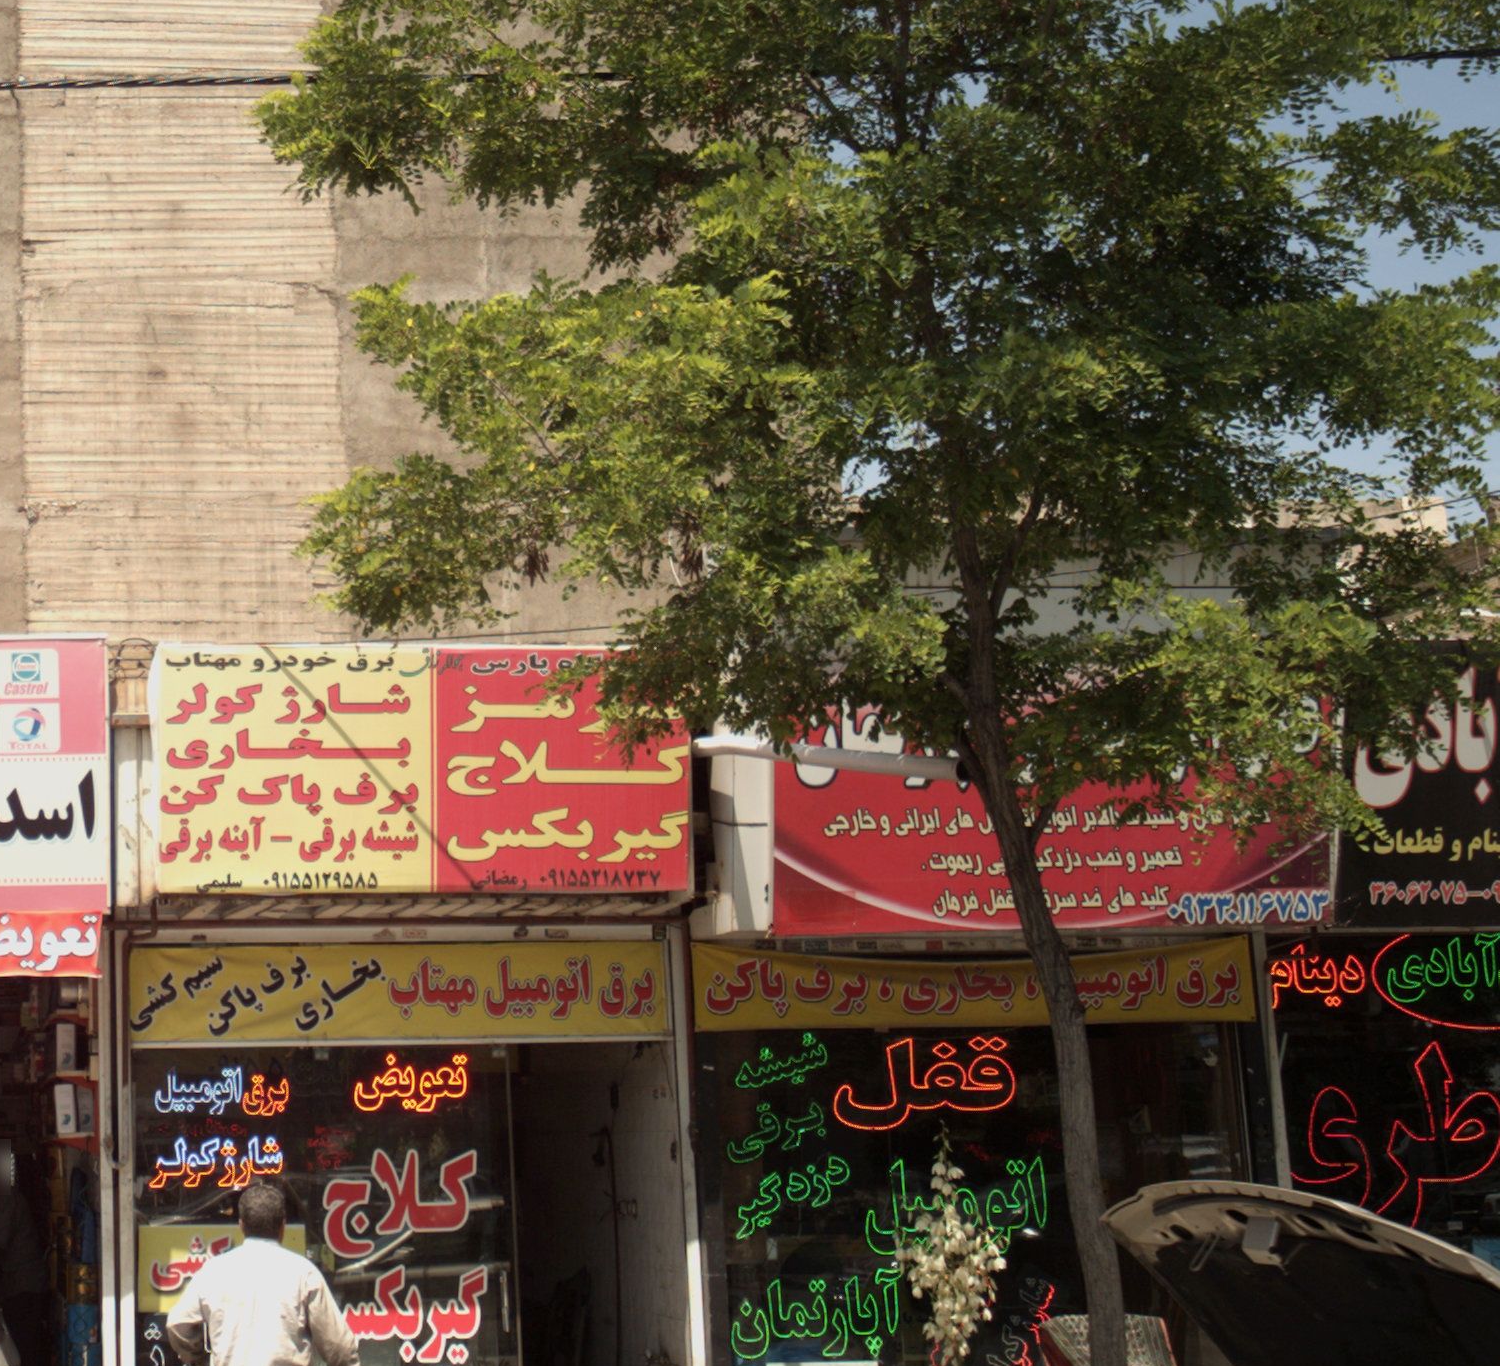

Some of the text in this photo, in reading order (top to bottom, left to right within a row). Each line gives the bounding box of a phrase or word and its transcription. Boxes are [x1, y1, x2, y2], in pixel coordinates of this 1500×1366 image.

[165, 651, 241, 672] مهتاب
[249, 651, 336, 673] خودرو
[346, 649, 395, 672] برق
[471, 651, 548, 677] پارس
[3, 682, 49, 695] Castrol
[166, 683, 411, 724] شارژ کولر
[166, 729, 411, 768] بخاری
[446, 740, 688, 797] کلاج
[159, 772, 419, 816] برف پاک کن
[159, 816, 419, 863] شیشه برقی آینه برقی
[824, 807, 877, 837] خارجی
[880, 813, 891, 836] و
[895, 807, 940, 836] ایرانی
[945, 807, 974, 836] های
[929, 853, 982, 876] ریموت
[1086, 848, 1122, 868] نصب
[1126, 851, 1136, 872] و
[1140, 846, 1183, 872] تعمیر
[1450, 839, 1462, 861] و
[933, 890, 979, 917] فرمان
[1081, 888, 1102, 908] ضد
[1107, 886, 1135, 913] های
[1140, 885, 1171, 907] کلید
[129, 954, 225, 1032] سیم کشی
[260, 952, 310, 996] برف
[294, 956, 387, 1032] بخاری
[388, 954, 655, 1020] برق اتومبیل مهتاب
[794, 961, 870, 1015] برف
[901, 963, 1015, 1013] بخاری
[1074, 953, 1168, 1010] اتومبی
[1175, 958, 1240, 1008] برق
[1270, 944, 1366, 1010] دینام
[735, 1032, 828, 1088] شیشه
[154, 1066, 290, 1116] برق اتومبیل
[354, 1053, 468, 1112] تعویض
[833, 1037, 1016, 1131] قفل
[727, 1102, 825, 1164] برقی
[149, 1136, 221, 1189] کولر
[217, 1135, 283, 1188] شارژ
[323, 1148, 477, 1259] کلاج
[731, 1267, 903, 1360] آپارتمان
